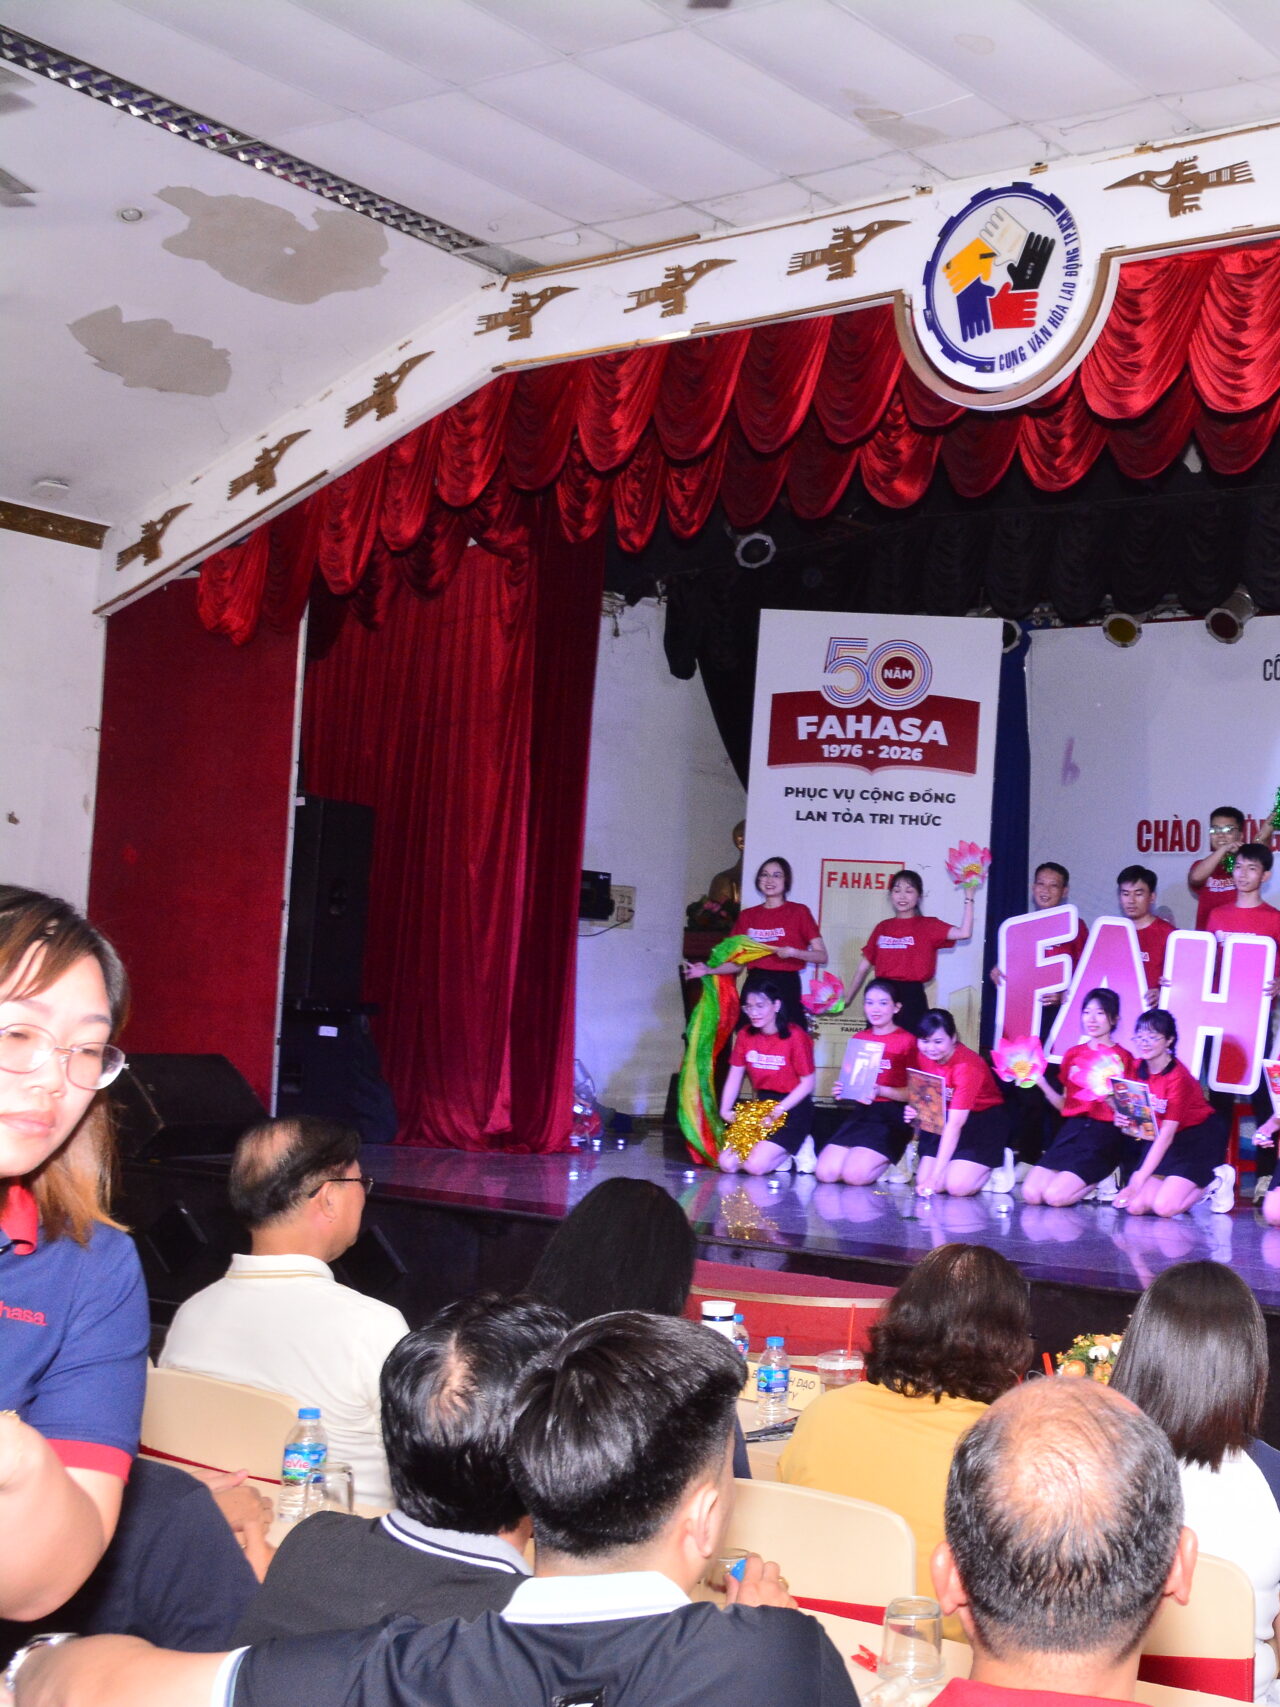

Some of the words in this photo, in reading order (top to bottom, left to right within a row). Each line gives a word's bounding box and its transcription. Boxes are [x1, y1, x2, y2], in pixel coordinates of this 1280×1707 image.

[1062, 248, 1083, 277] ĐỘNG
[1061, 281, 1077, 302] LAO
[1027, 325, 1053, 353] VĂN
[999, 347, 1027, 371] CUNG
[824, 637, 933, 706] 50
[883, 666, 914, 680] NĂM
[797, 715, 948, 746] FAHASA
[821, 744, 863, 758] 1976
[878, 746, 923, 761] 2026
[784, 786, 828, 801] PHỤC
[833, 788, 855, 803] VỤ
[859, 787, 905, 805] CỘNG
[909, 788, 956, 804] ĐỒNG
[795, 810, 827, 822] LAN
[869, 813, 894, 825] TRI
[899, 812, 942, 826] THỨC
[1136, 813, 1200, 852] CHÀO
[0, 1300, 47, 1326] hasa
